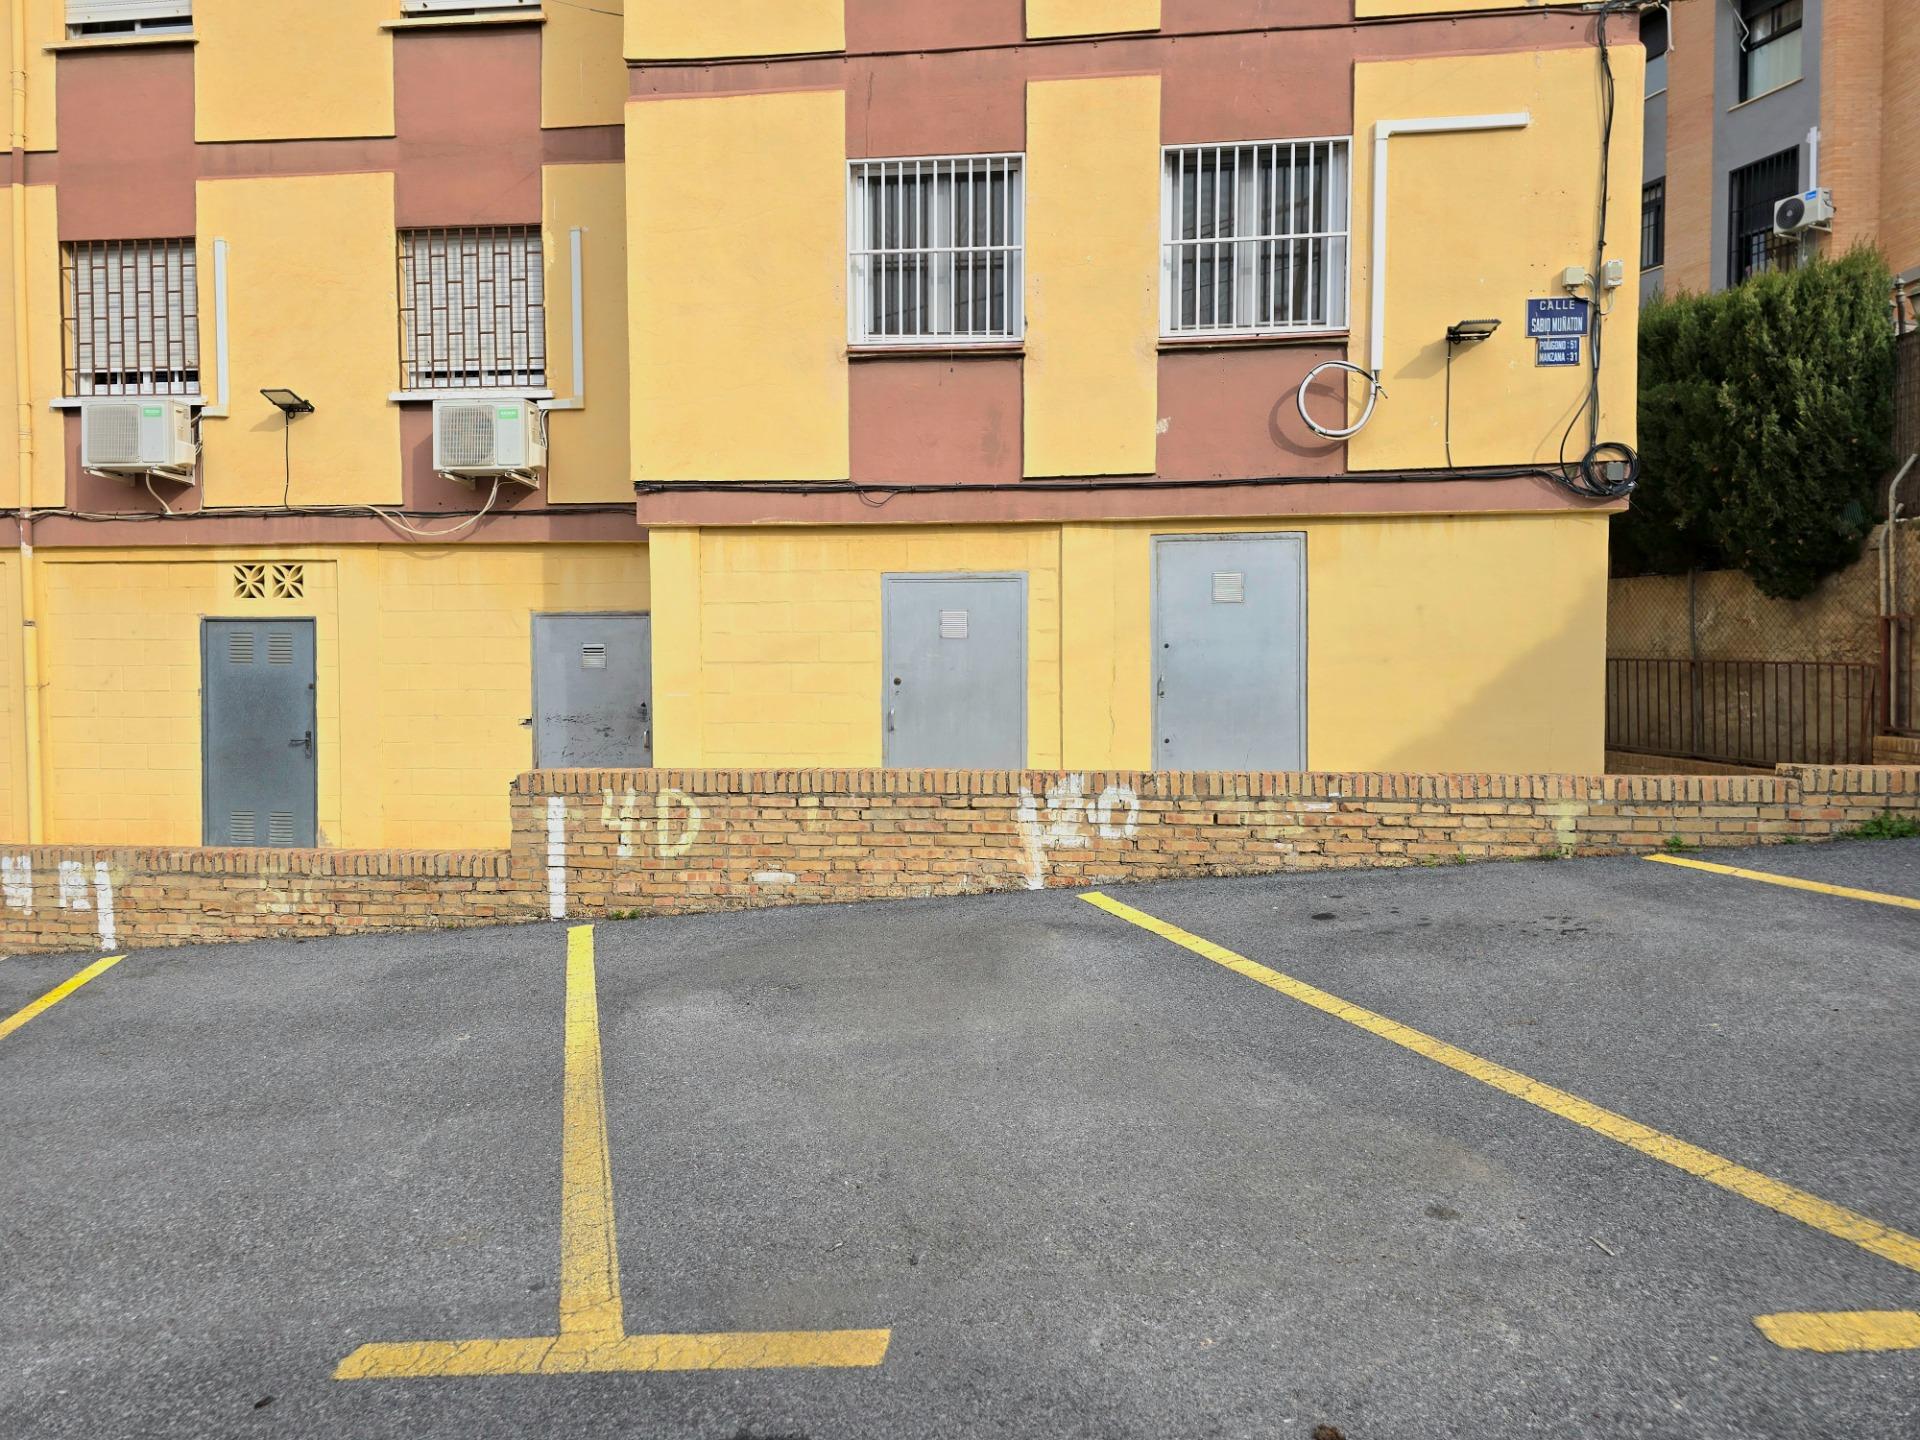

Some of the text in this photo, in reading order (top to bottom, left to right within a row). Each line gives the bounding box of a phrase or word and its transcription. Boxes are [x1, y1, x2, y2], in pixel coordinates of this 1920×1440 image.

[1540, 300, 1575, 310] CALLE
[1532, 318, 1551, 332] SABIO
[1539, 352, 1566, 361] MANZANA
